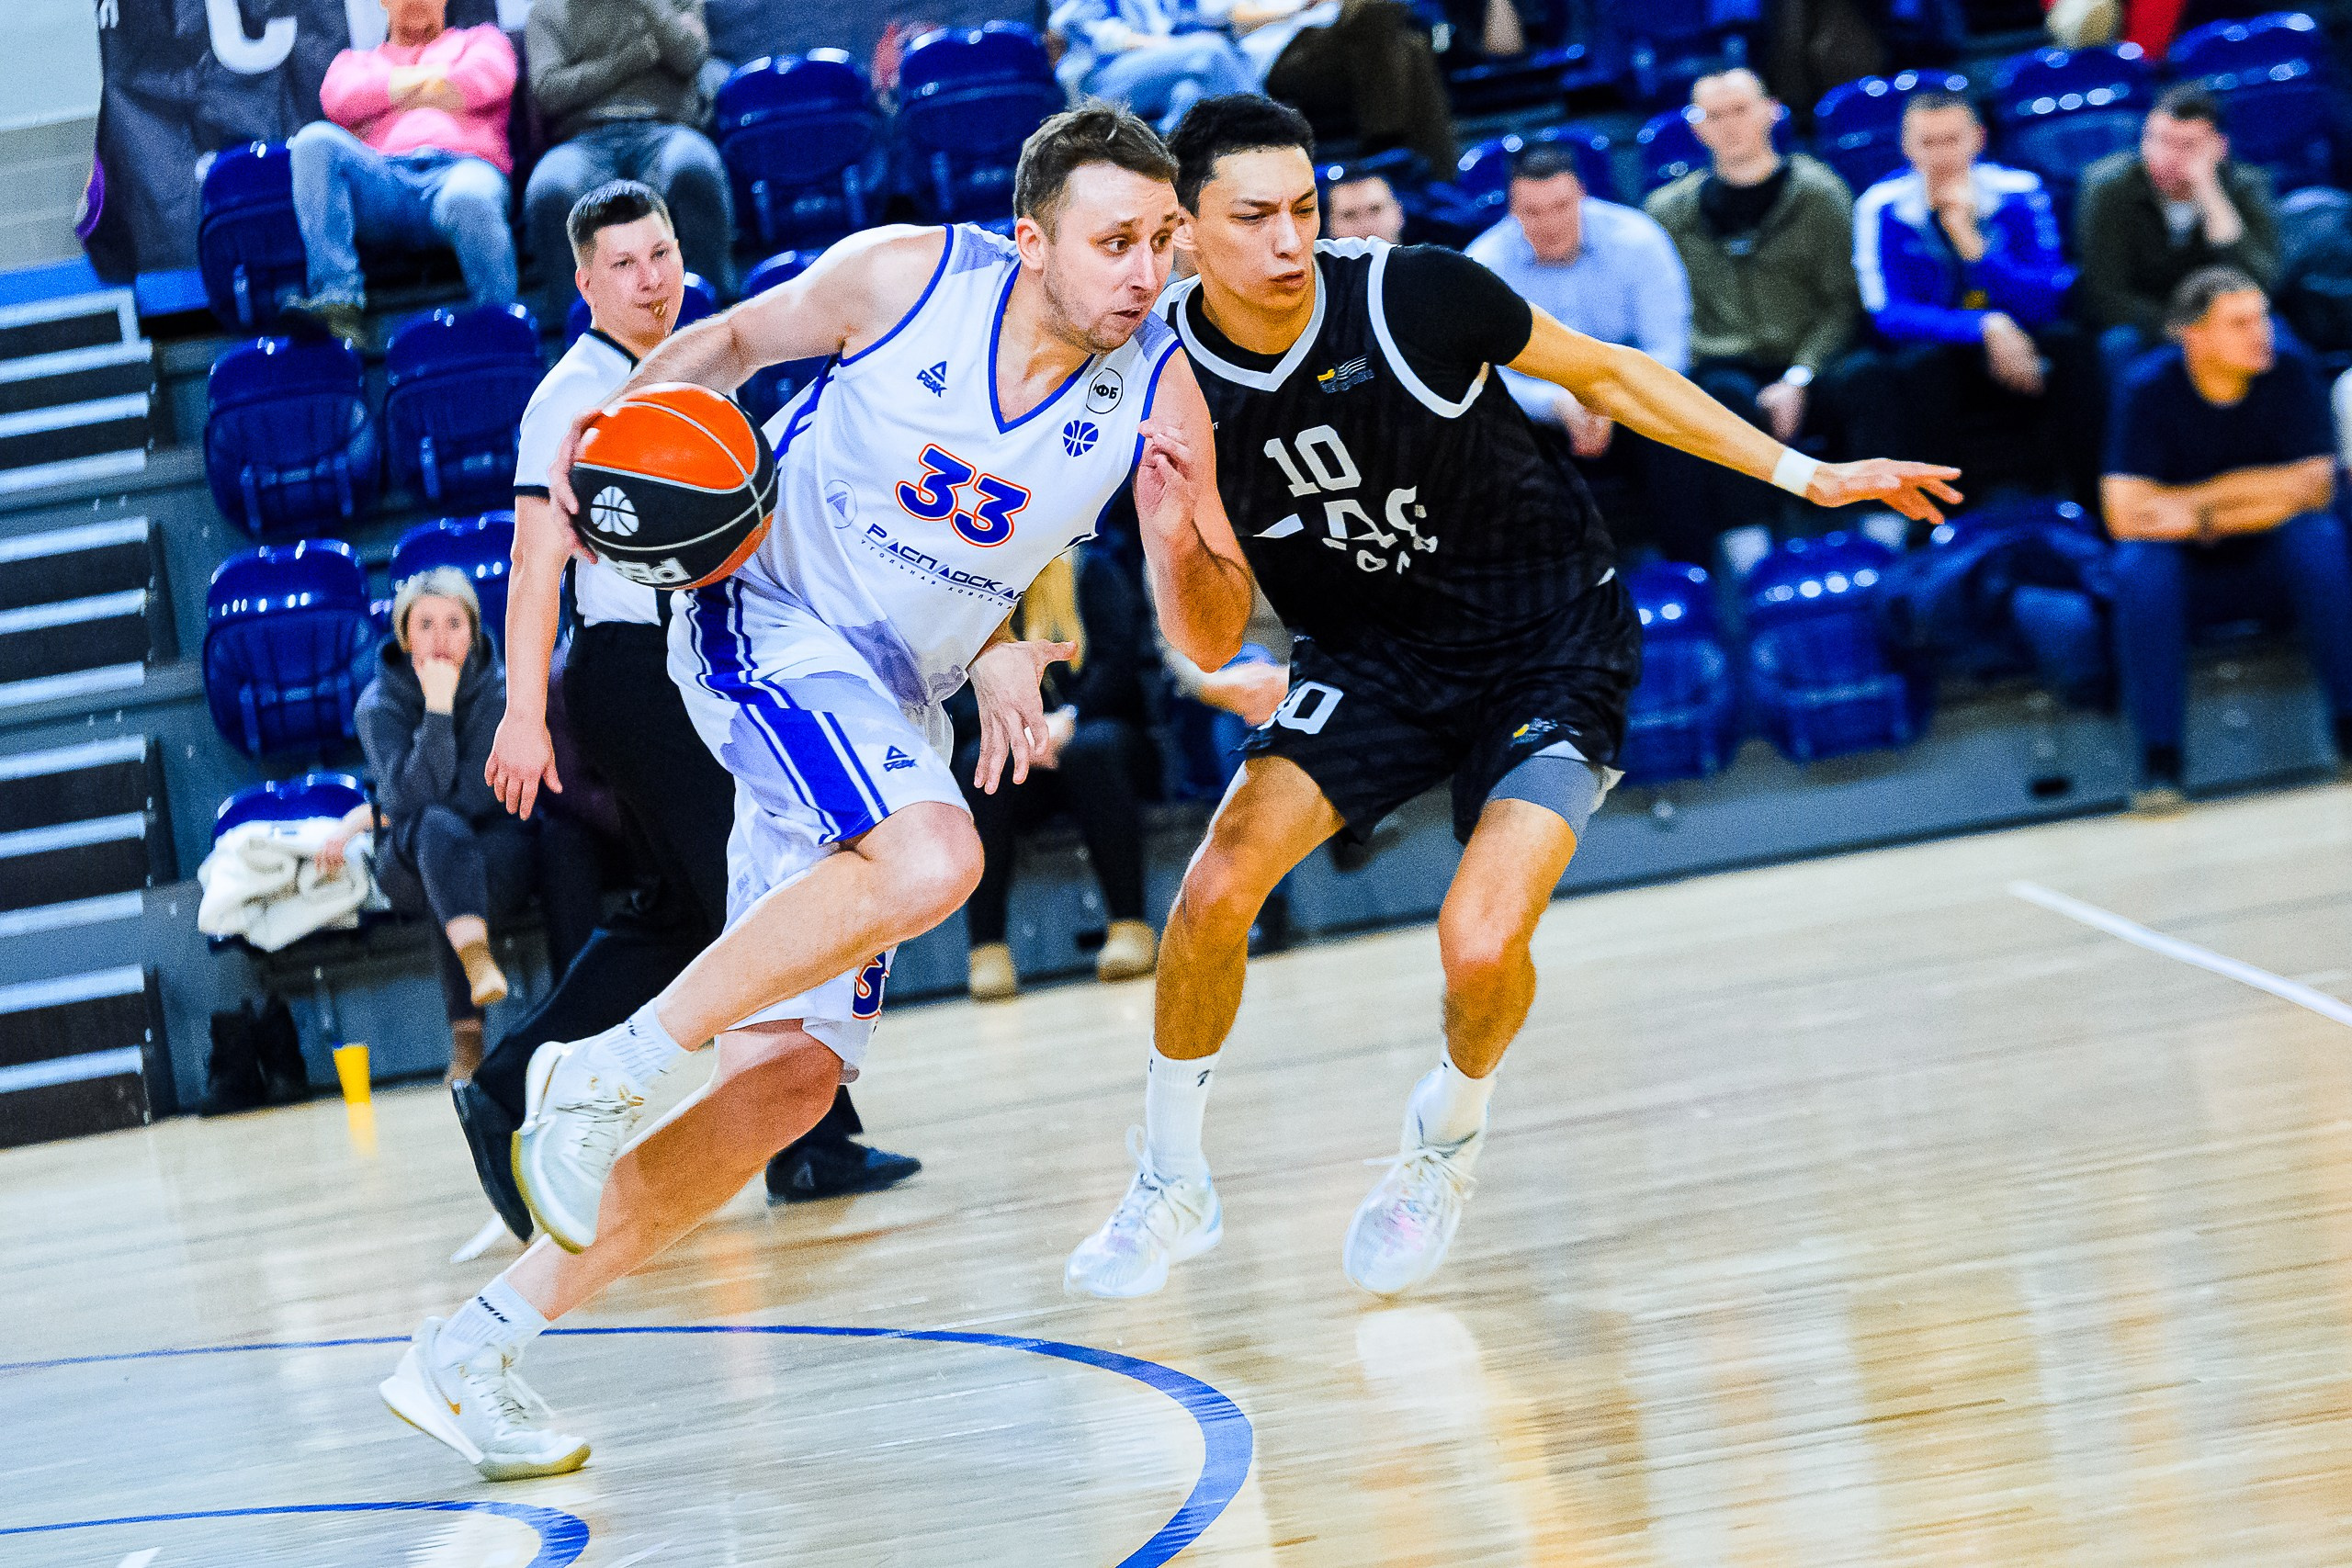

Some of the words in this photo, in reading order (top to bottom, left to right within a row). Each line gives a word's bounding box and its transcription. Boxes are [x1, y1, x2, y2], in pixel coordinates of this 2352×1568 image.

[916, 369, 948, 399] PEAK
[1092, 383, 1119, 400] ФБ
[1263, 424, 1362, 498] 10
[895, 444, 1031, 548] 33
[861, 538, 936, 586] УГОЛЬНАЯ
